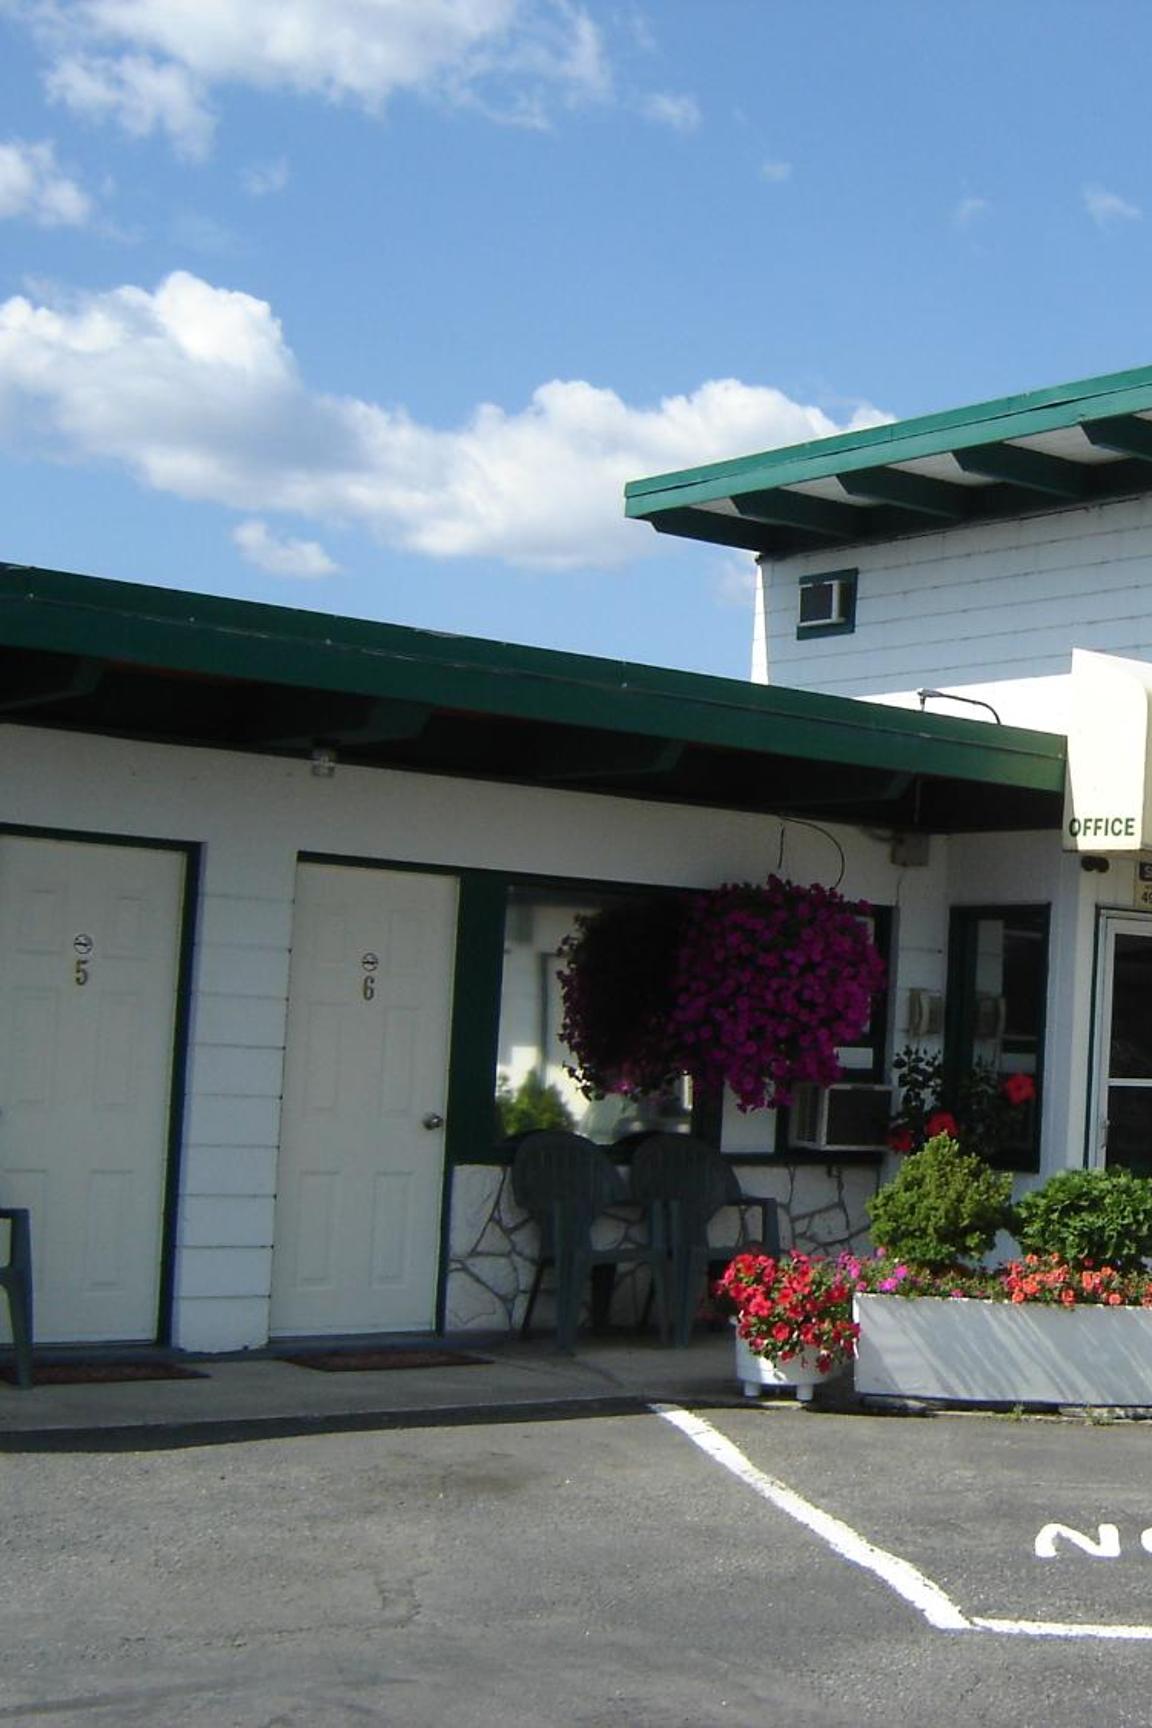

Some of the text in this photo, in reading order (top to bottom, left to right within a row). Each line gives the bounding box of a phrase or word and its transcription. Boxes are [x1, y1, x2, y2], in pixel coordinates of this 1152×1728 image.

[1069, 817, 1136, 837] OFFICE
[76, 959, 88, 986] 5
[363, 975, 375, 1001] 6
